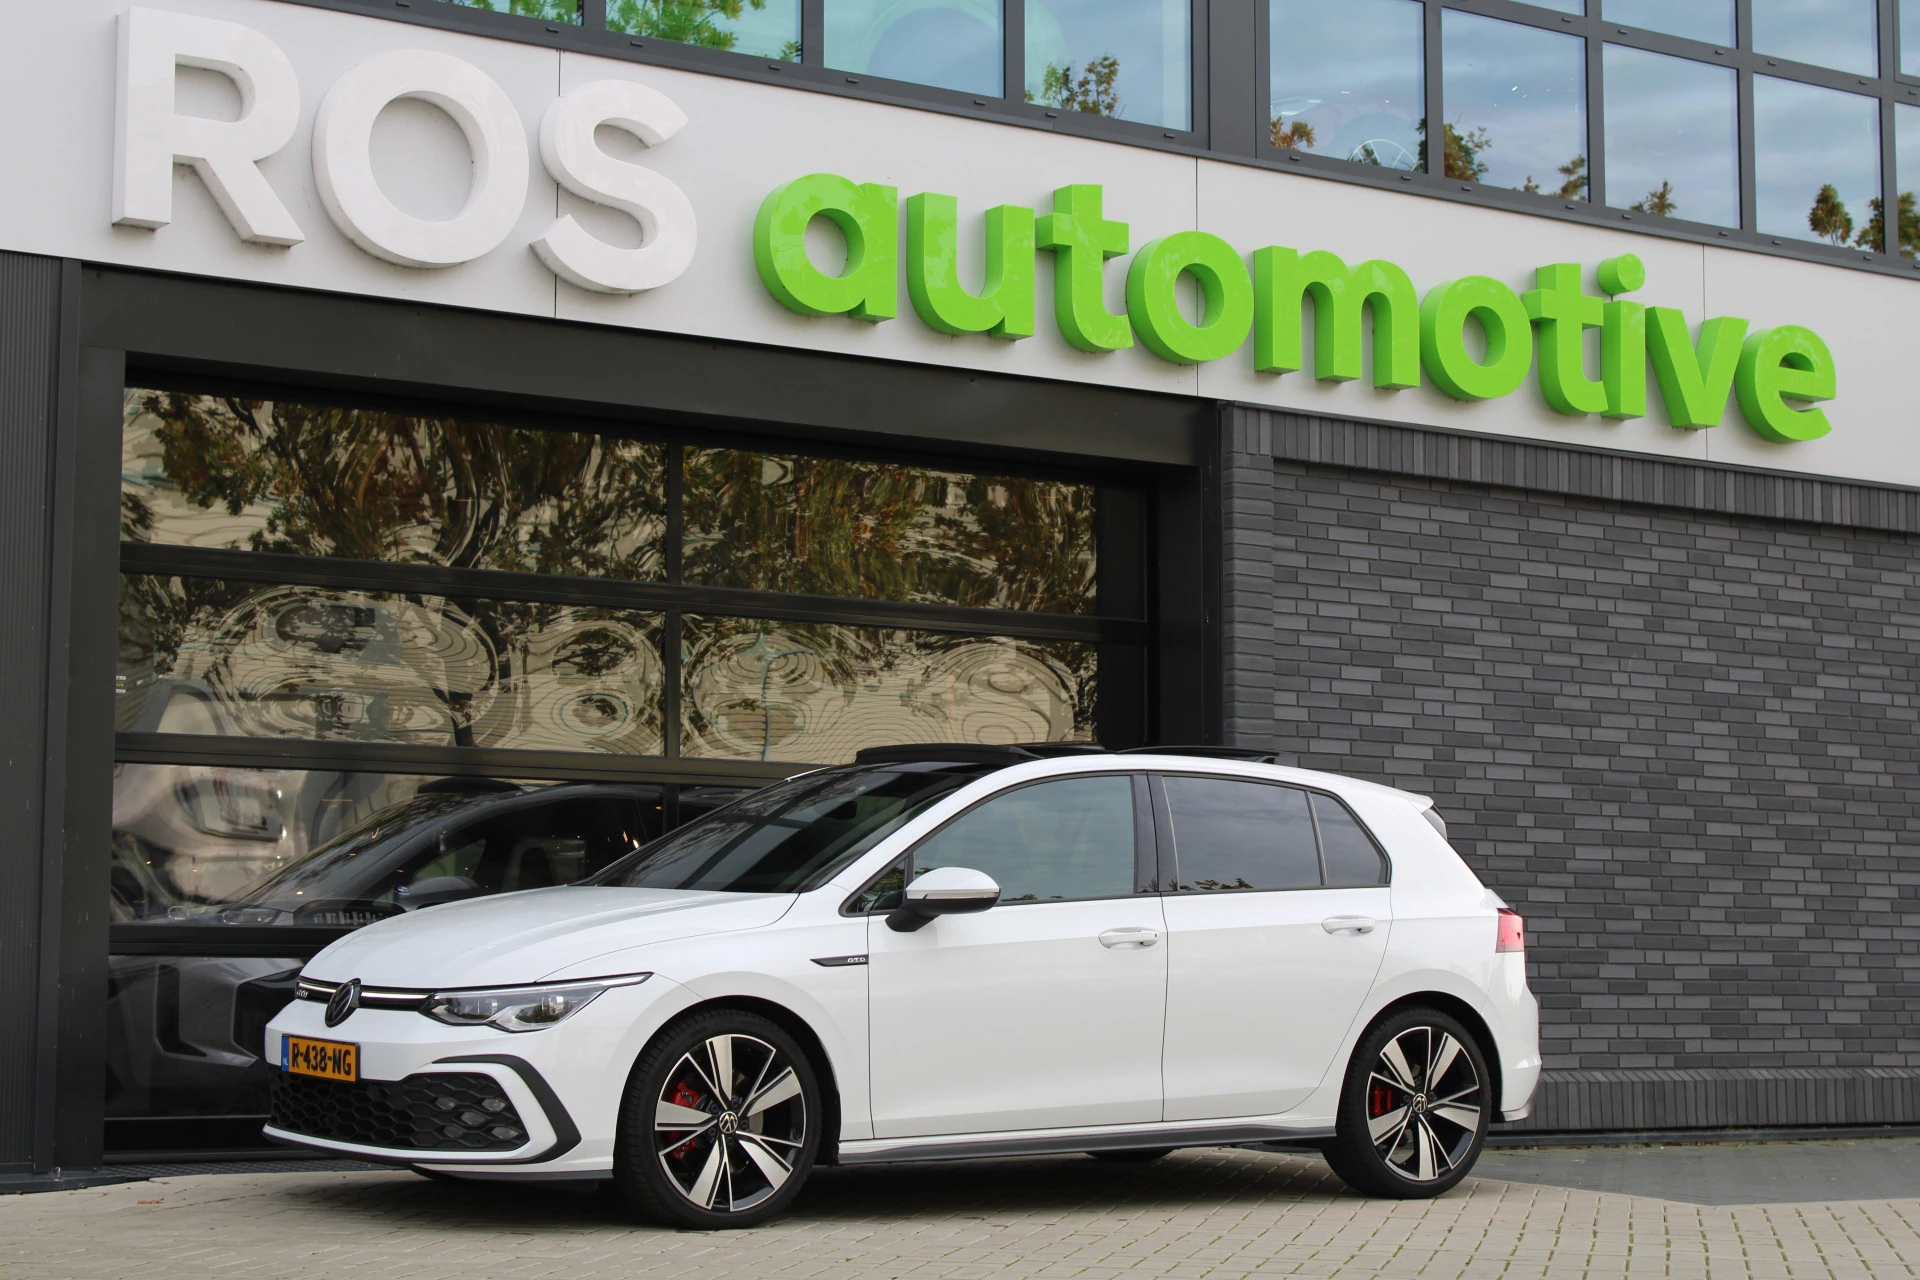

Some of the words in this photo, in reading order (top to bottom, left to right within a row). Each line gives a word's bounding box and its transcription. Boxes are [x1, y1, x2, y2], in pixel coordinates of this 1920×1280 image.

[112, 6, 698, 295] ROS
[754, 174, 1836, 443] automotive
[291, 1042, 352, 1076] R-438-NG
